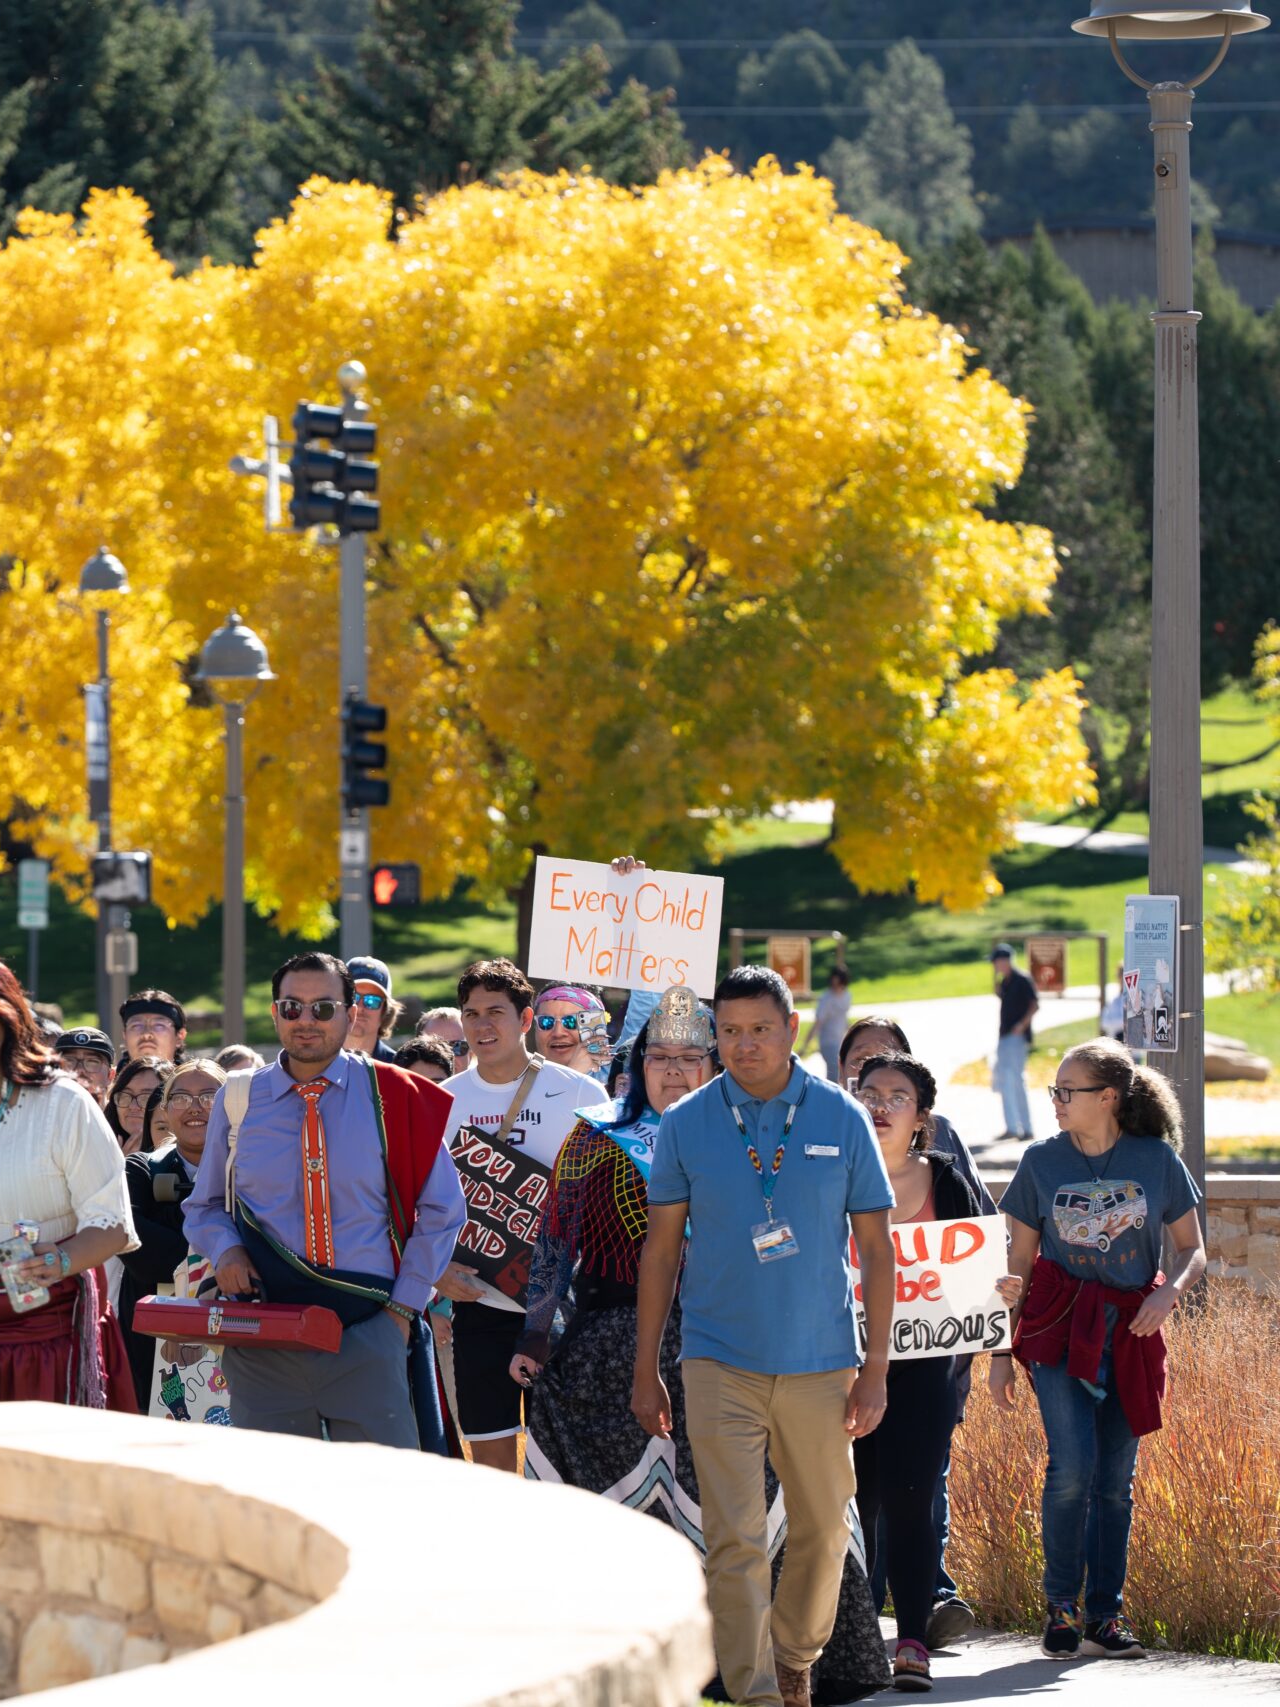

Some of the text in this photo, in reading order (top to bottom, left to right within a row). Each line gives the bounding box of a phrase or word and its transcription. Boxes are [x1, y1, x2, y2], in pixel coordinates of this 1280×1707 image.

[550, 872, 708, 931] Every Child
[1134, 932, 1168, 940] WITH PLANTS
[1151, 922, 1169, 931] NATIVE
[565, 926, 689, 986] Matters
[450, 1128, 515, 1184] YOU
[896, 1270, 944, 1303] be
